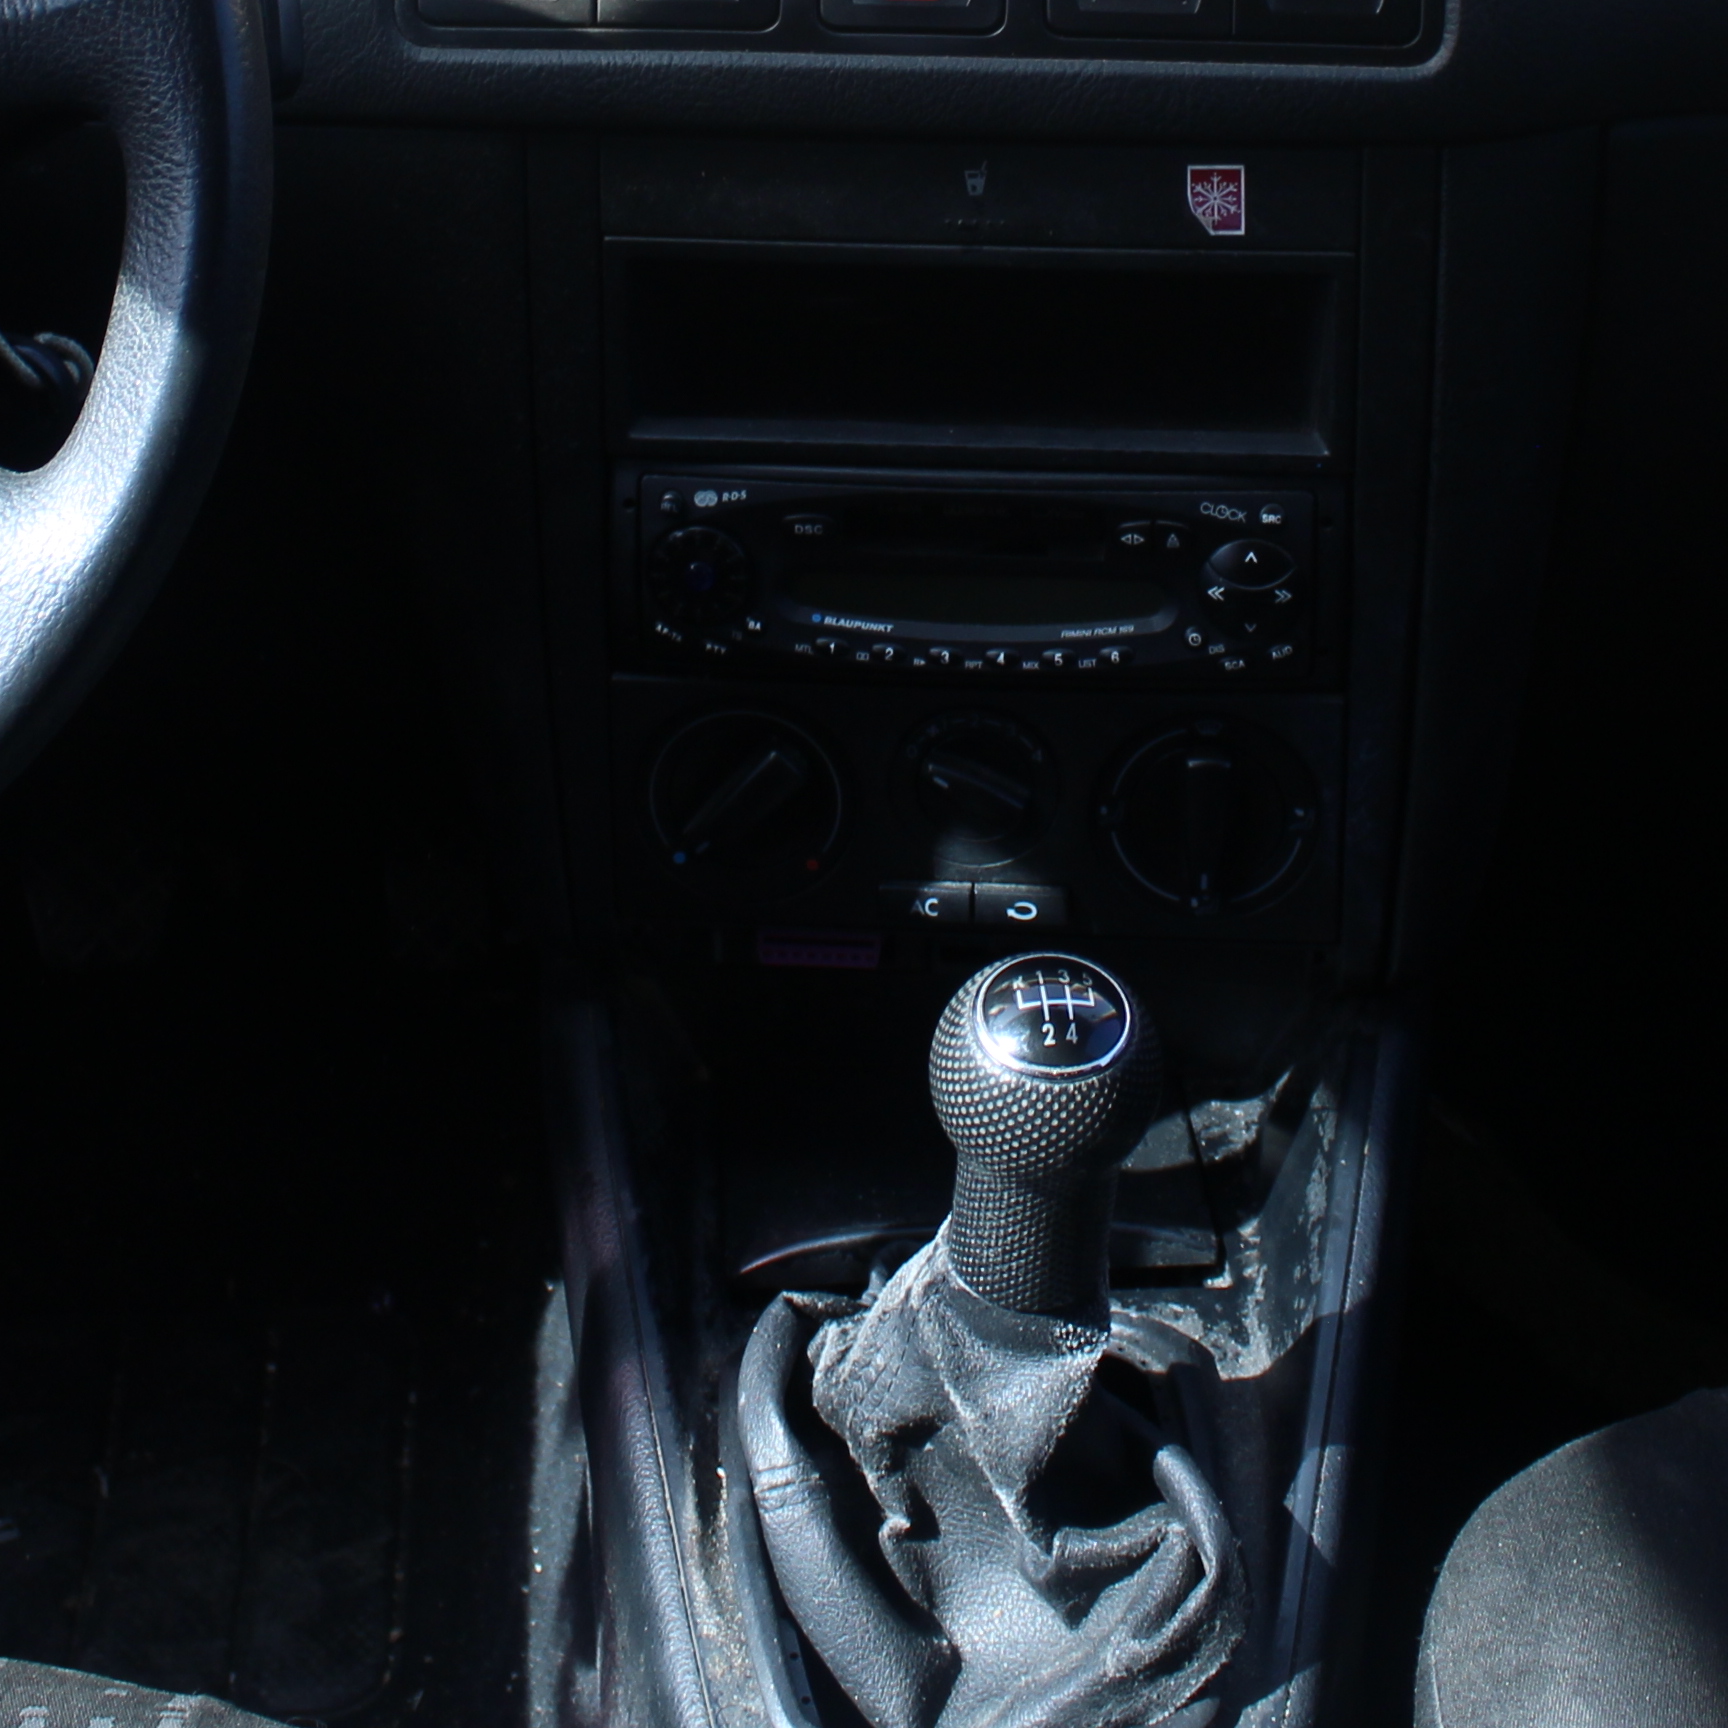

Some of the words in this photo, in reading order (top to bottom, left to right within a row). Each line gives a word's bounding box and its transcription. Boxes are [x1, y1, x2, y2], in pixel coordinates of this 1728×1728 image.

[1199, 501, 1248, 524] CLOCK
[1261, 513, 1282, 525] SRC
[793, 523, 824, 536] DSC
[822, 615, 896, 634] BLAUPUNKT
[828, 642, 836, 655] 1
[884, 647, 895, 662] 2
[1208, 643, 1226, 656] DIS
[1271, 645, 1294, 661] AUD
[939, 649, 951, 665] 3
[964, 659, 984, 670] RPT
[995, 651, 1006, 667] 4
[1053, 652, 1064, 667] 5
[1078, 658, 1098, 669] LIST
[1110, 651, 1121, 665] 6
[1022, 660, 1040, 670] MIX
[908, 896, 940, 918] AC
[1036, 970, 1045, 984] 1
[1058, 969, 1071, 984] 3
[1042, 1024, 1056, 1046] 2
[1065, 1023, 1078, 1045] 4
